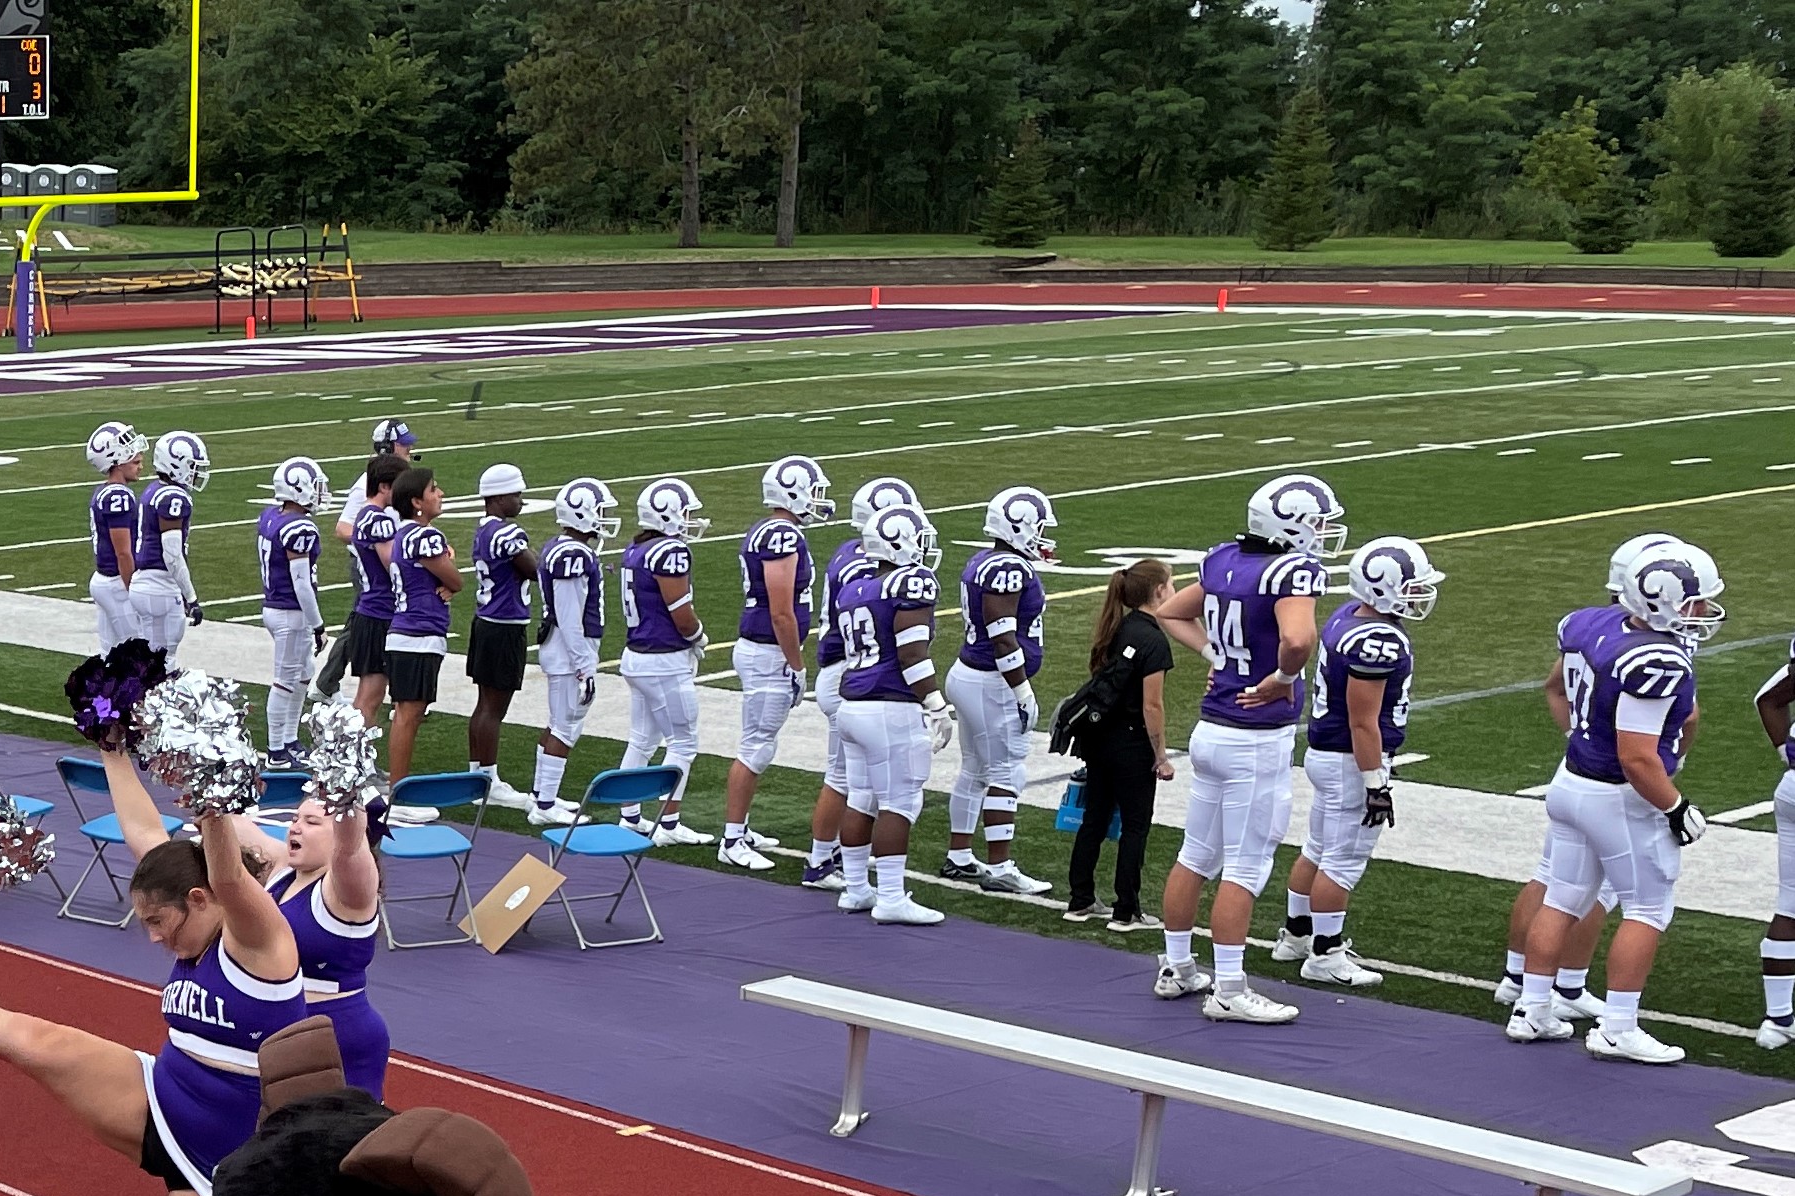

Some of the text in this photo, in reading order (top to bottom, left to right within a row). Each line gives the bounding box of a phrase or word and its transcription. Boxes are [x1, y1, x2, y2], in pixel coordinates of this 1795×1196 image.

[29, 53, 40, 75] 0
[32, 82, 41, 100] 3
[1, 95, 6, 113] 1
[22, 104, 45, 116] T.O.L.
[110, 494, 129, 511] 21
[169, 499, 182, 516] 8
[371, 519, 394, 538] 40
[294, 535, 317, 553] 47
[419, 537, 443, 557] 43
[767, 531, 798, 553] 42
[563, 557, 584, 577] 14
[662, 552, 689, 574] 45
[906, 577, 937, 600] 93
[991, 570, 1023, 593] 48
[1291, 569, 1327, 596] 94
[838, 606, 880, 669] 93
[1204, 594, 1250, 676] 94
[1359, 639, 1399, 663] 55
[1637, 667, 1684, 697] 77
[161, 980, 235, 1029] ORNELL
